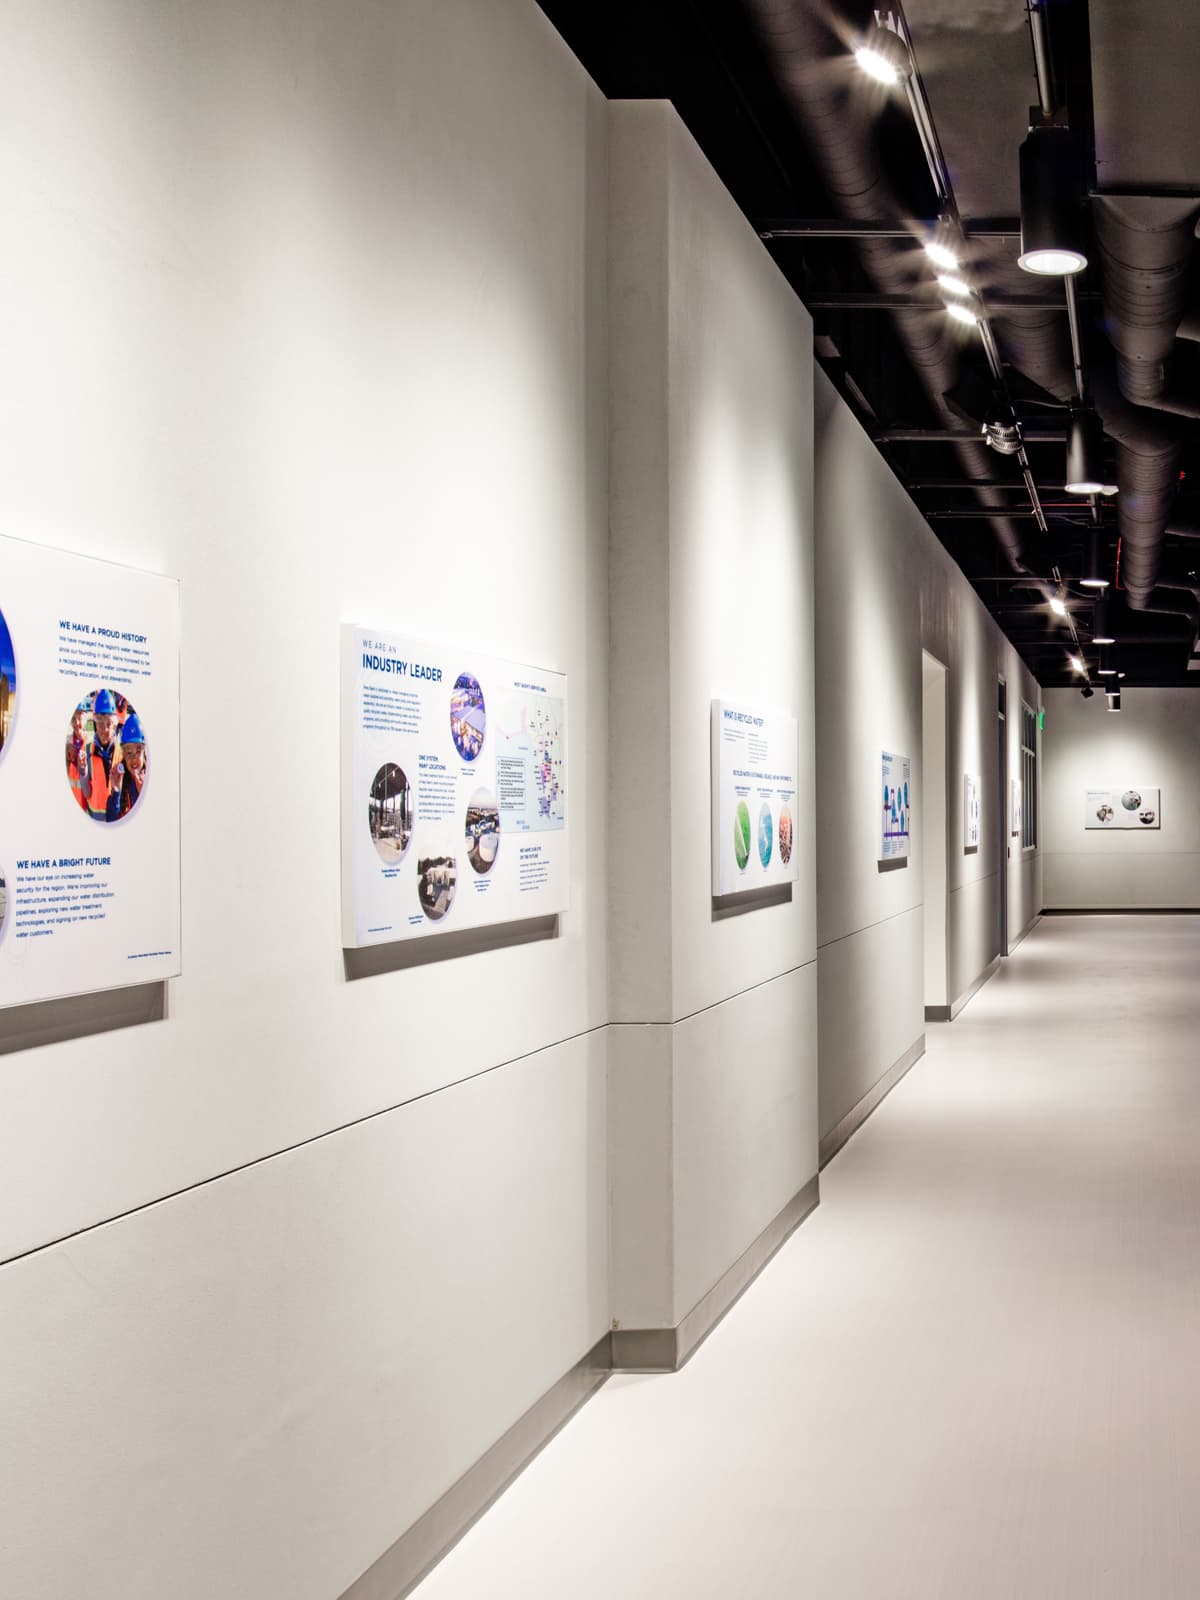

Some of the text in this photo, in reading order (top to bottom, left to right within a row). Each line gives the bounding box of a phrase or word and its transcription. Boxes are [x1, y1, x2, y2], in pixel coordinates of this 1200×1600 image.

[59, 620, 70, 630] WE
[72, 623, 89, 633] HAVE
[98, 628, 119, 639] PROUD
[121, 632, 147, 643] HISTORY
[362, 640, 372, 649] WE
[375, 642, 386, 652] ARE
[363, 653, 442, 682] INDUSTRY LEADER
[17, 857, 111, 869] WE HAVE A BRIGHT FUTURE
